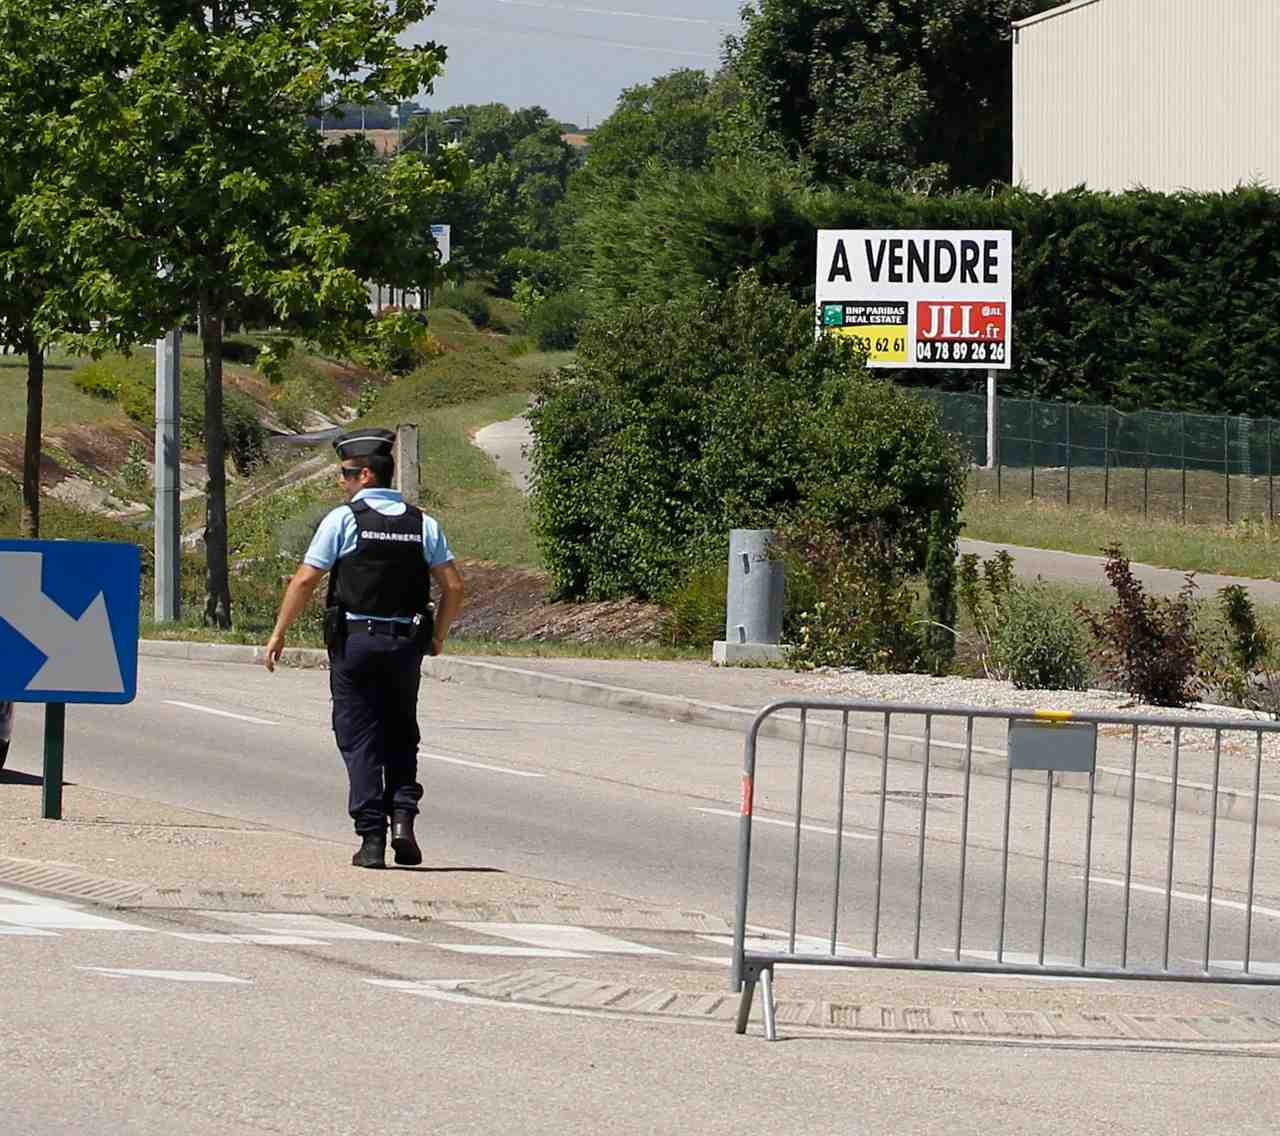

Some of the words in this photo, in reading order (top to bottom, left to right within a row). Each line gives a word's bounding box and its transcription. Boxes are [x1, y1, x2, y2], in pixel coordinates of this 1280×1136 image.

[827, 238, 852, 282] A
[864, 238, 999, 283] VENDRE
[866, 307, 905, 315] PARIBAS
[845, 315, 868, 323] REAL
[869, 315, 902, 323] ESTATE
[876, 337, 889, 352] 62
[893, 337, 905, 352] 61
[917, 342, 932, 360] 04
[935, 342, 949, 360] 78
[953, 342, 967, 360] 89
[971, 342, 986, 360] 26
[989, 342, 1004, 360] 26
[361, 530, 422, 542] GENDARMERIE
